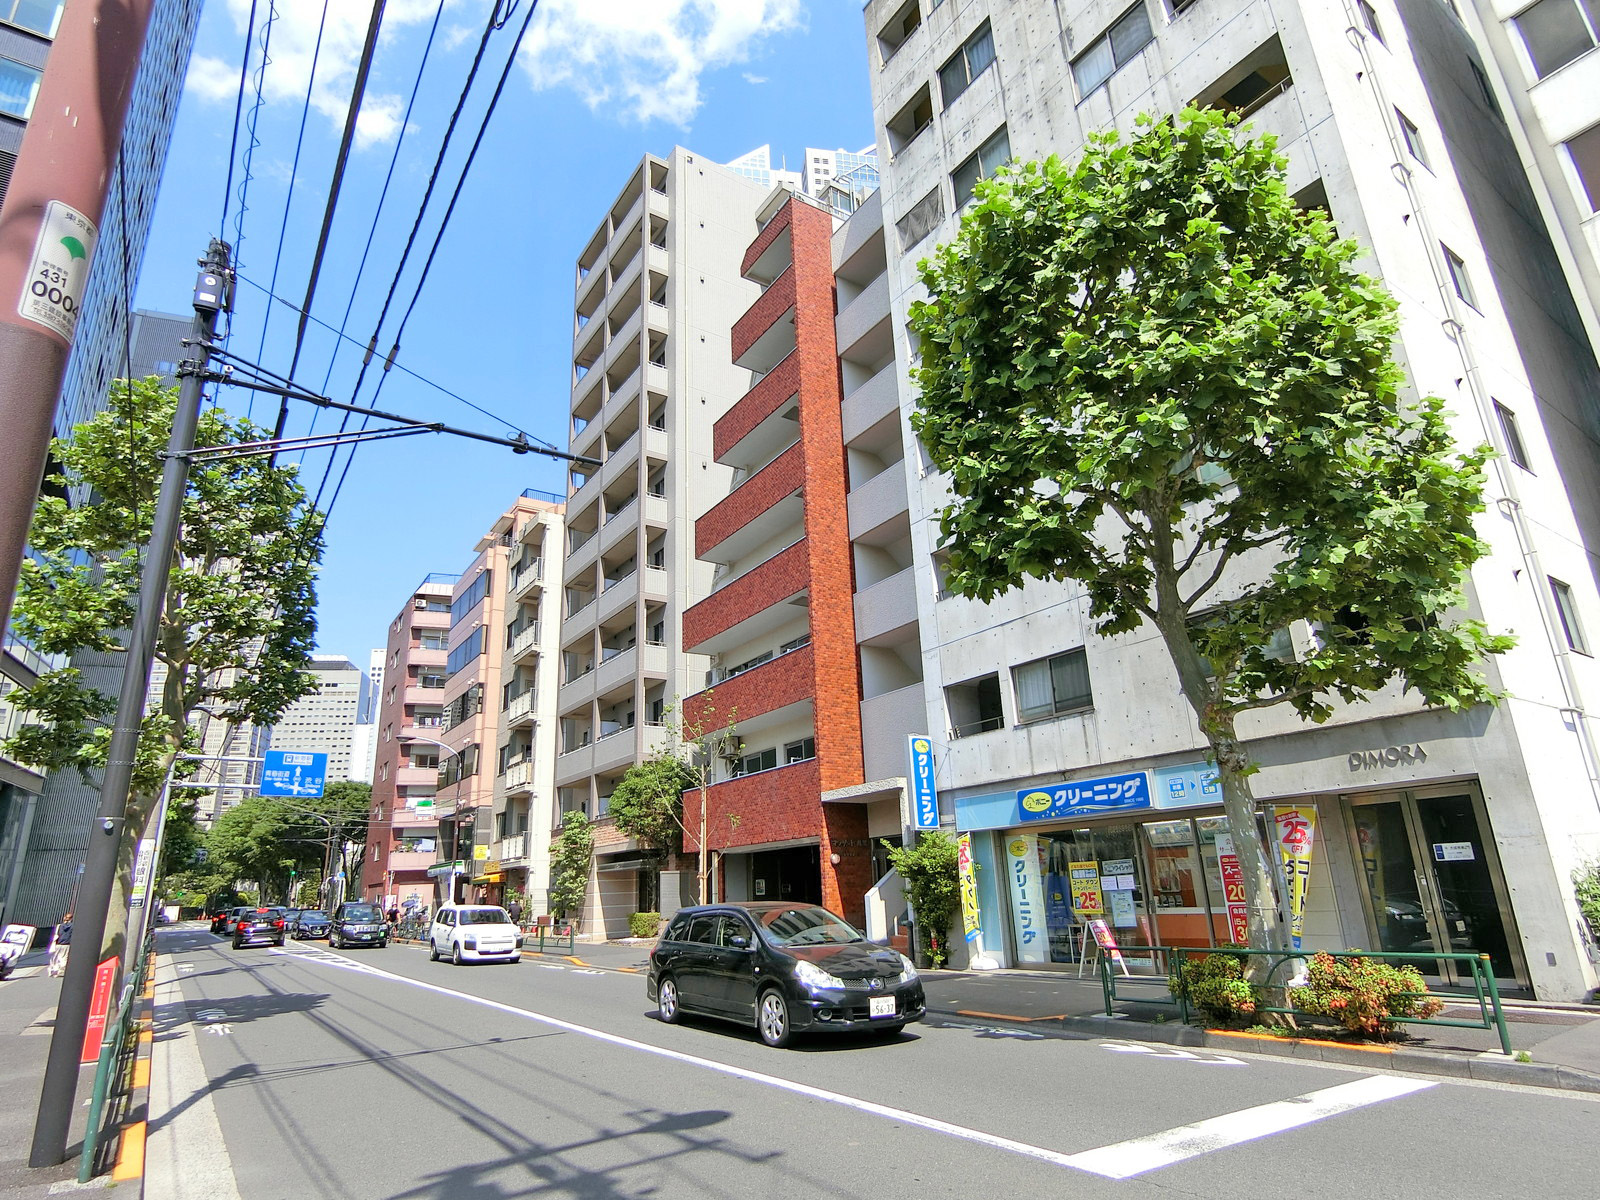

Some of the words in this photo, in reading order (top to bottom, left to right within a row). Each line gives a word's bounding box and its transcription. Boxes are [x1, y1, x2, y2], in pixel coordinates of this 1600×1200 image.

[64, 211, 95, 238] 東京都
[40, 268, 67, 288] 431
[1348, 743, 1428, 772] DIMORA
[917, 754, 935, 826] クリーニング
[1054, 777, 1141, 807] クリーニング
[1171, 790, 1185, 798] 12時
[1203, 785, 1216, 794] 5時
[1282, 820, 1312, 845] 25%
[1014, 859, 1036, 945] クリーニング
[1237, 926, 1248, 941] 3
[875, 1003, 894, 1014] 56-37
